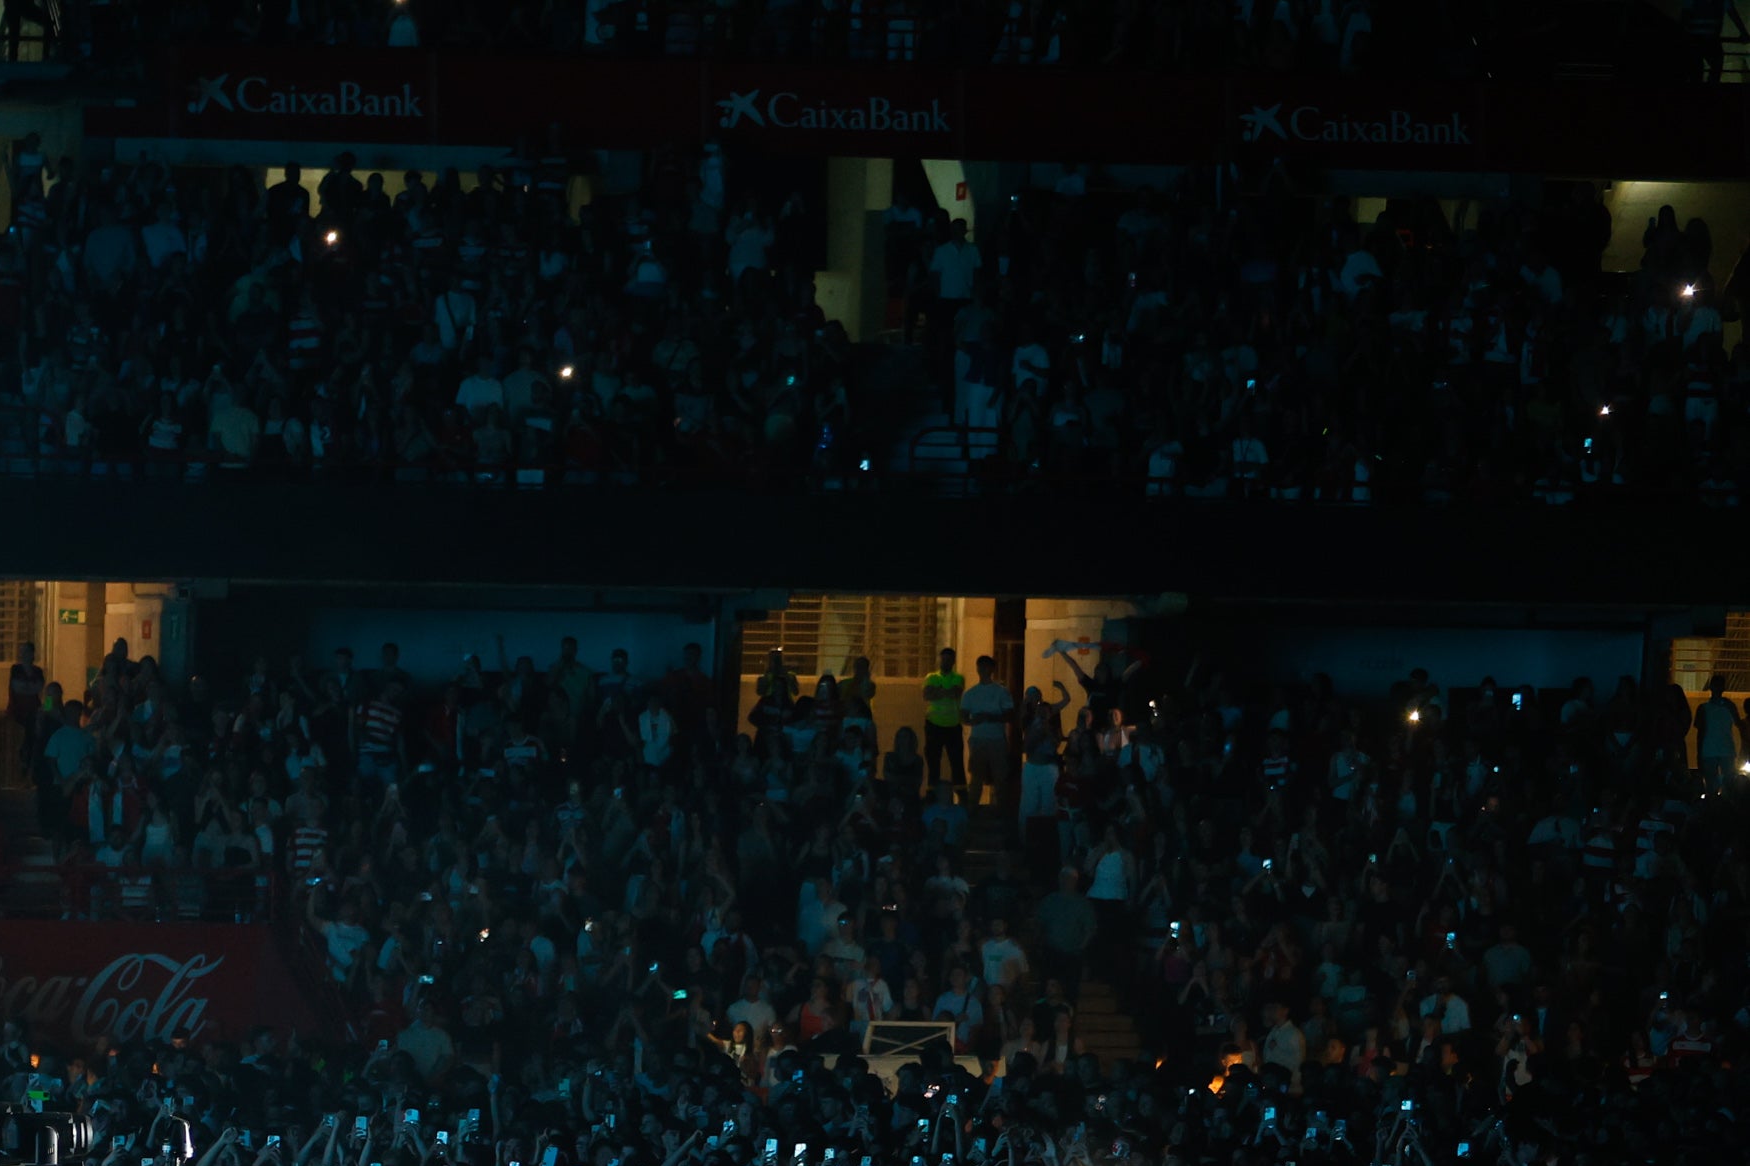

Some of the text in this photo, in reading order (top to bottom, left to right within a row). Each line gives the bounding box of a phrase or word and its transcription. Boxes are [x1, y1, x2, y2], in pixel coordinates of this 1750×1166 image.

[235, 77, 424, 118] CaixaBank
[767, 92, 952, 133] CaixaBank
[1289, 106, 1472, 145] CaixaBank
